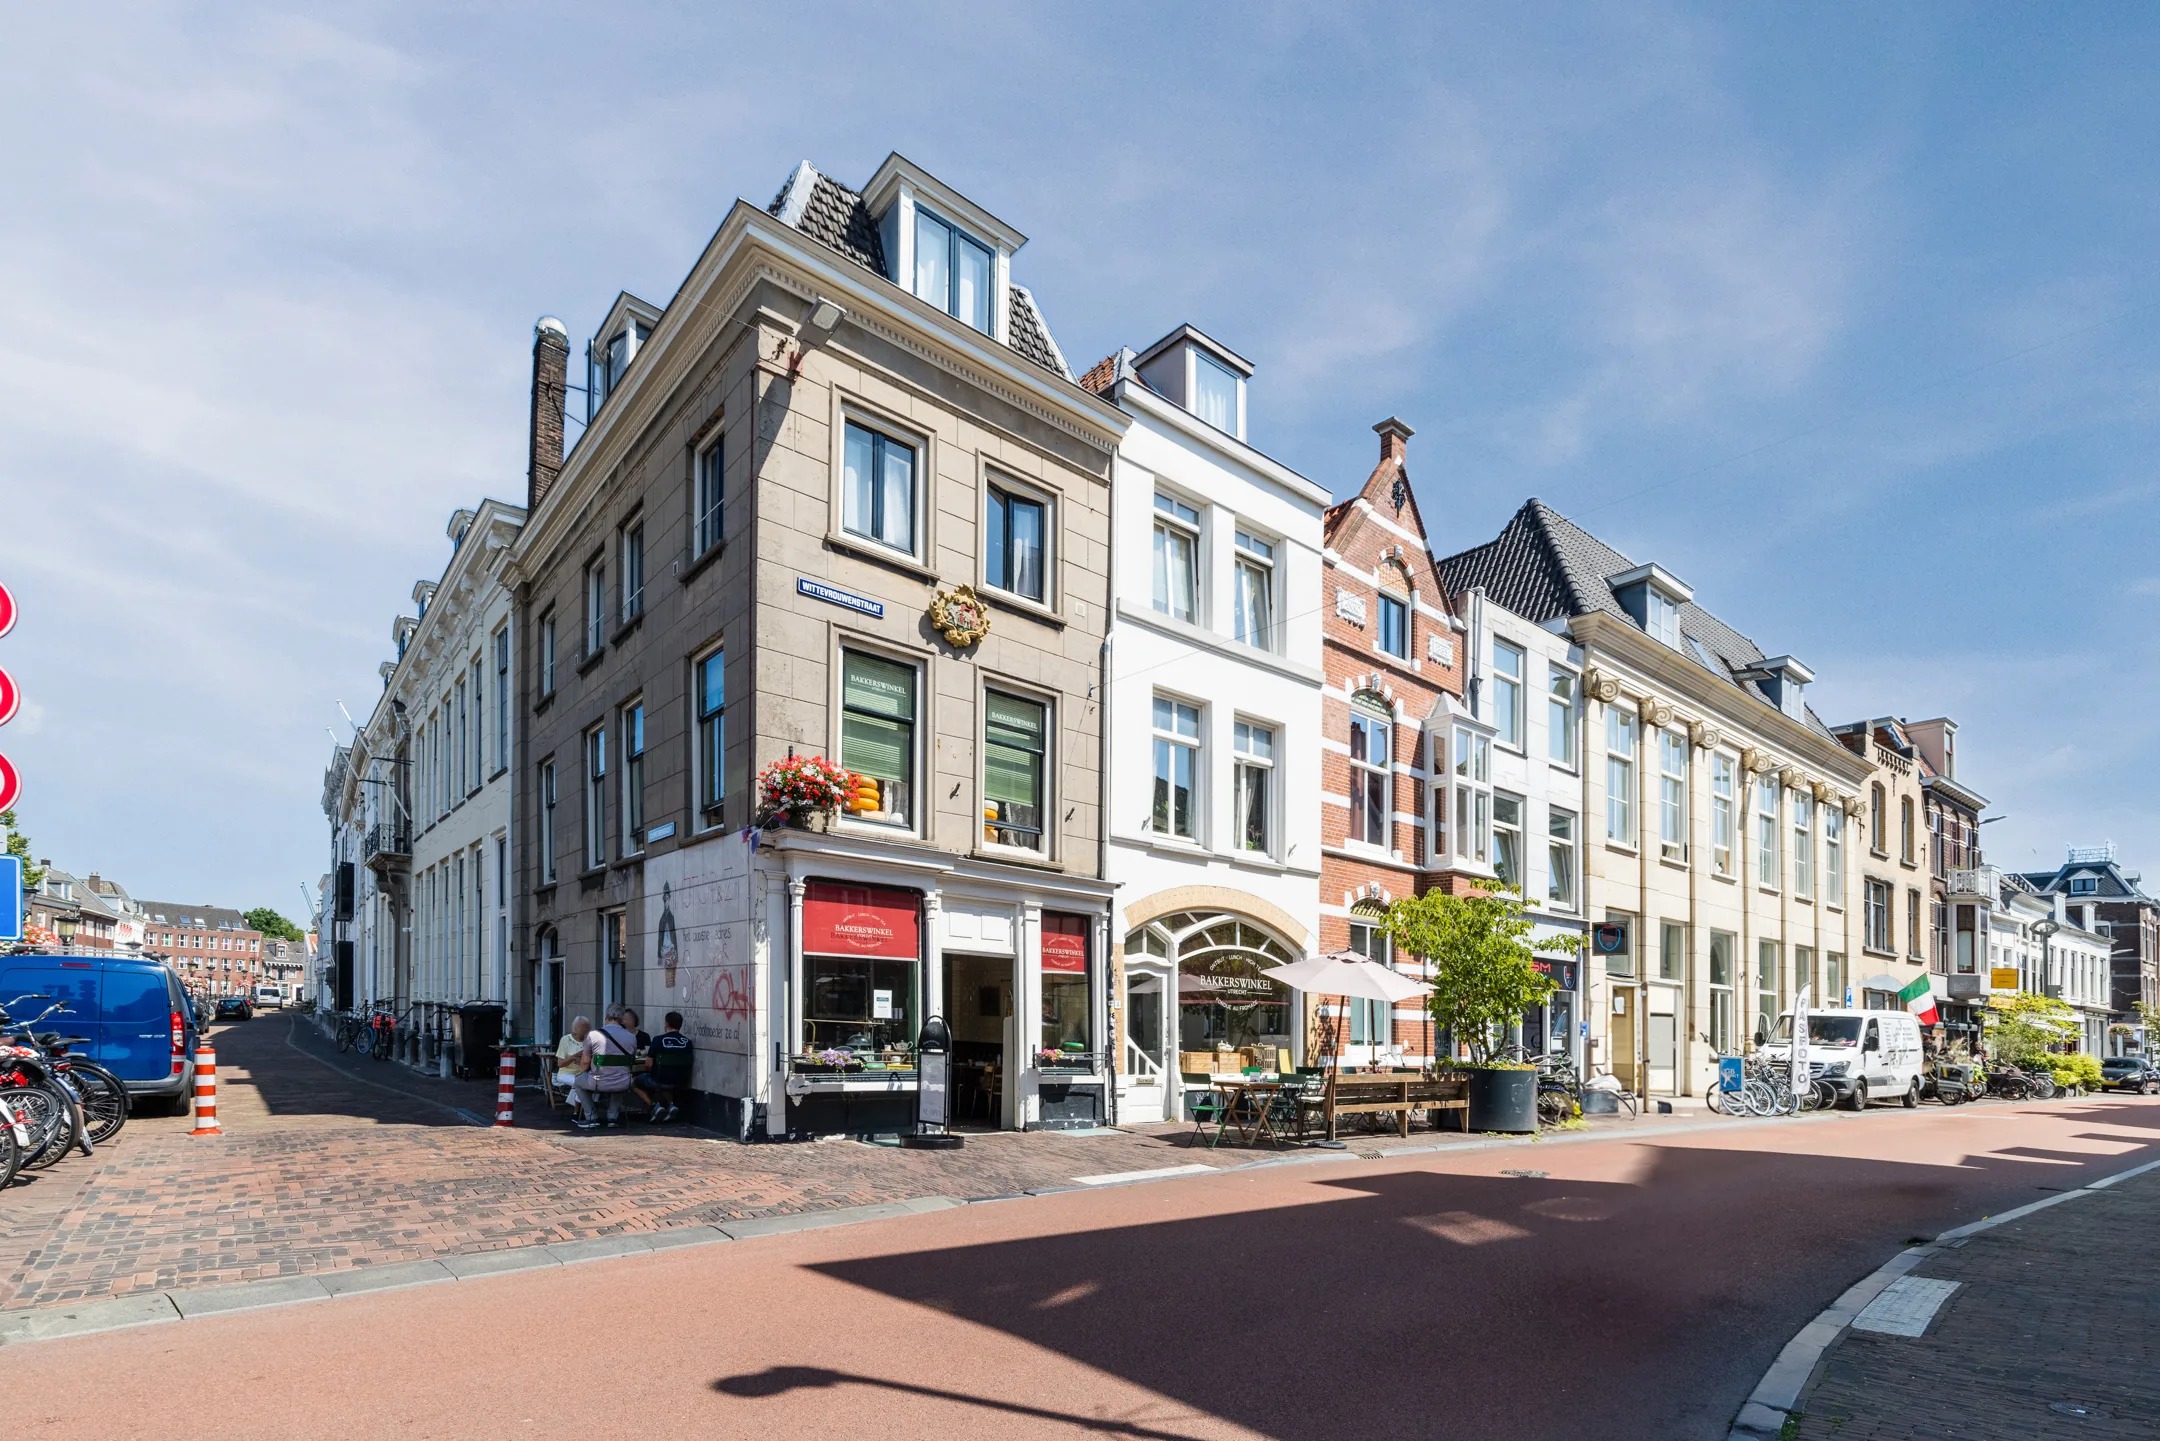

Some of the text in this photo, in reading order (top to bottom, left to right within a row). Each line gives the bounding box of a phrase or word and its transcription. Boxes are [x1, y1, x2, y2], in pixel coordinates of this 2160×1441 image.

[802, 581, 881, 613] WITTEVROUWENSTRAAT
[850, 674, 907, 694] BAKKERSWINKEL
[991, 711, 1038, 729] BAKKERSWINKEL
[835, 924, 893, 936] BAKKERSWINKEL
[1042, 946, 1085, 957] BAKKERSWINKEL
[1200, 975, 1272, 990] BAKKERSWINKEL
[1797, 998, 1808, 1083] PASFOTO
